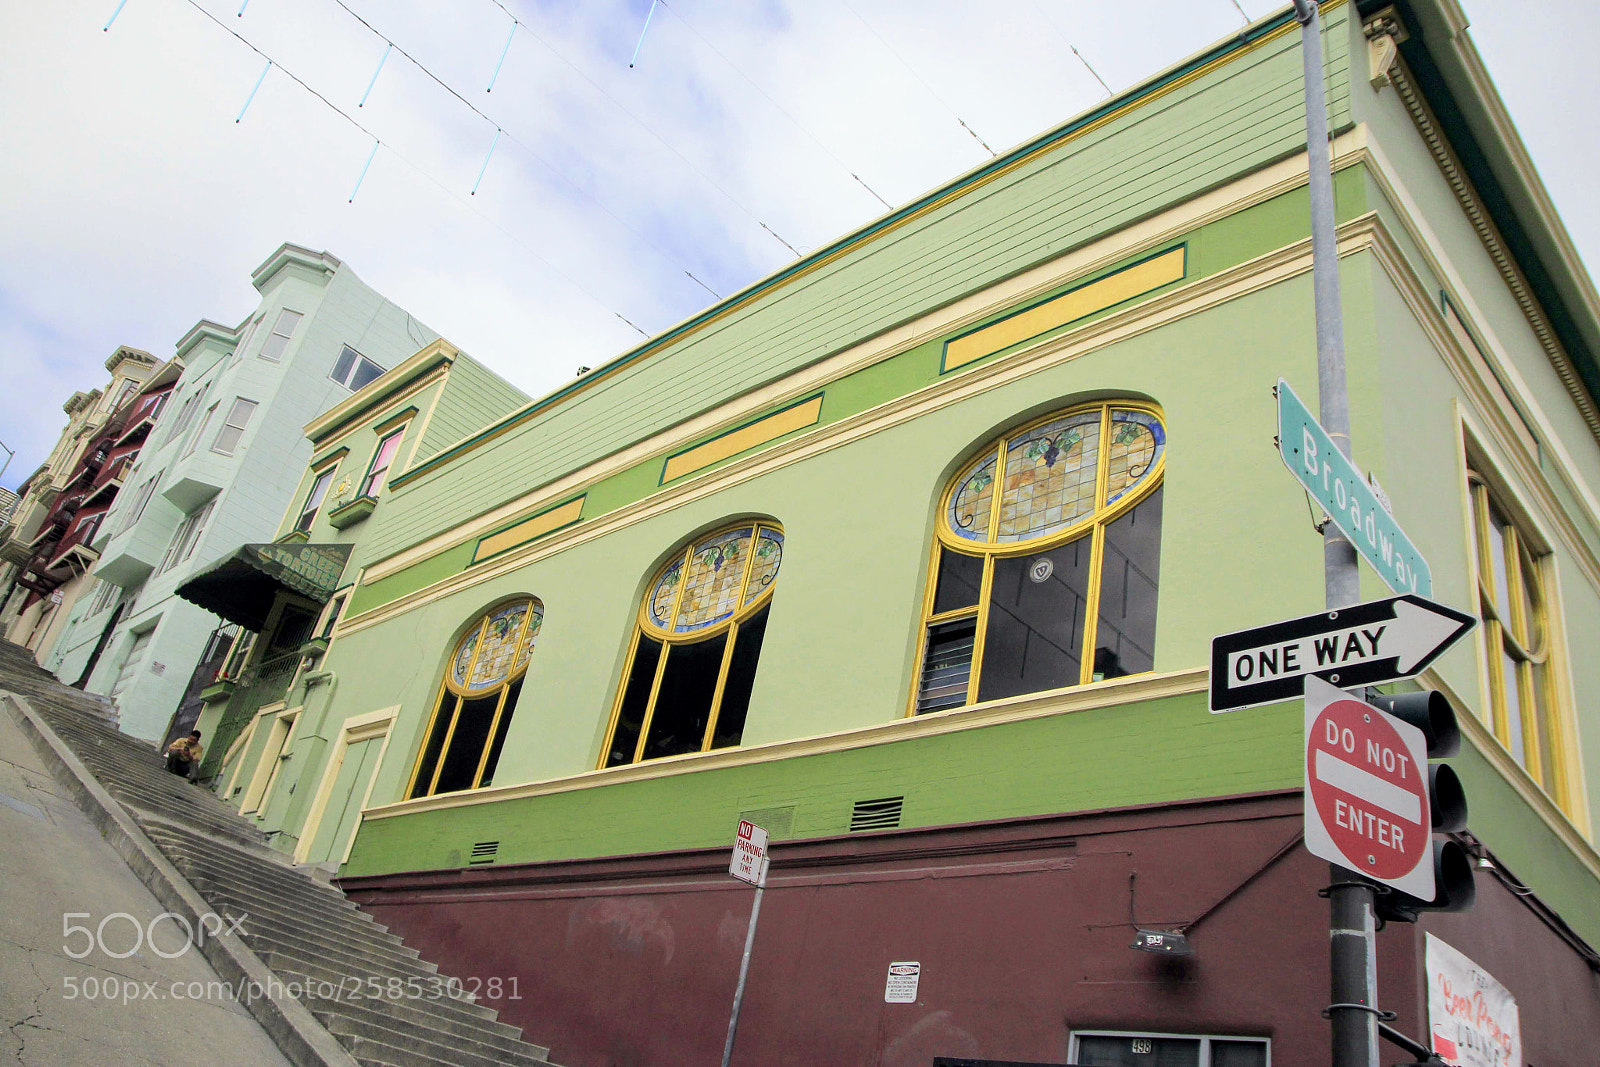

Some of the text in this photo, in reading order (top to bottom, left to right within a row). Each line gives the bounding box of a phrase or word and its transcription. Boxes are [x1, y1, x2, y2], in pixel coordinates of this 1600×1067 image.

[1302, 426, 1418, 593] Broadway
[276, 548, 338, 591] TORTOISE
[300, 547, 343, 578] GREEN
[1235, 625, 1387, 682] ONE WAY
[1326, 718, 1409, 779] DO NOT
[739, 822, 752, 838] NO
[1335, 799, 1405, 853] ENTER
[737, 838, 763, 858] PARKING
[742, 853, 754, 865] ANY
[739, 862, 752, 875] TIME
[1133, 1039, 1151, 1053] 498
